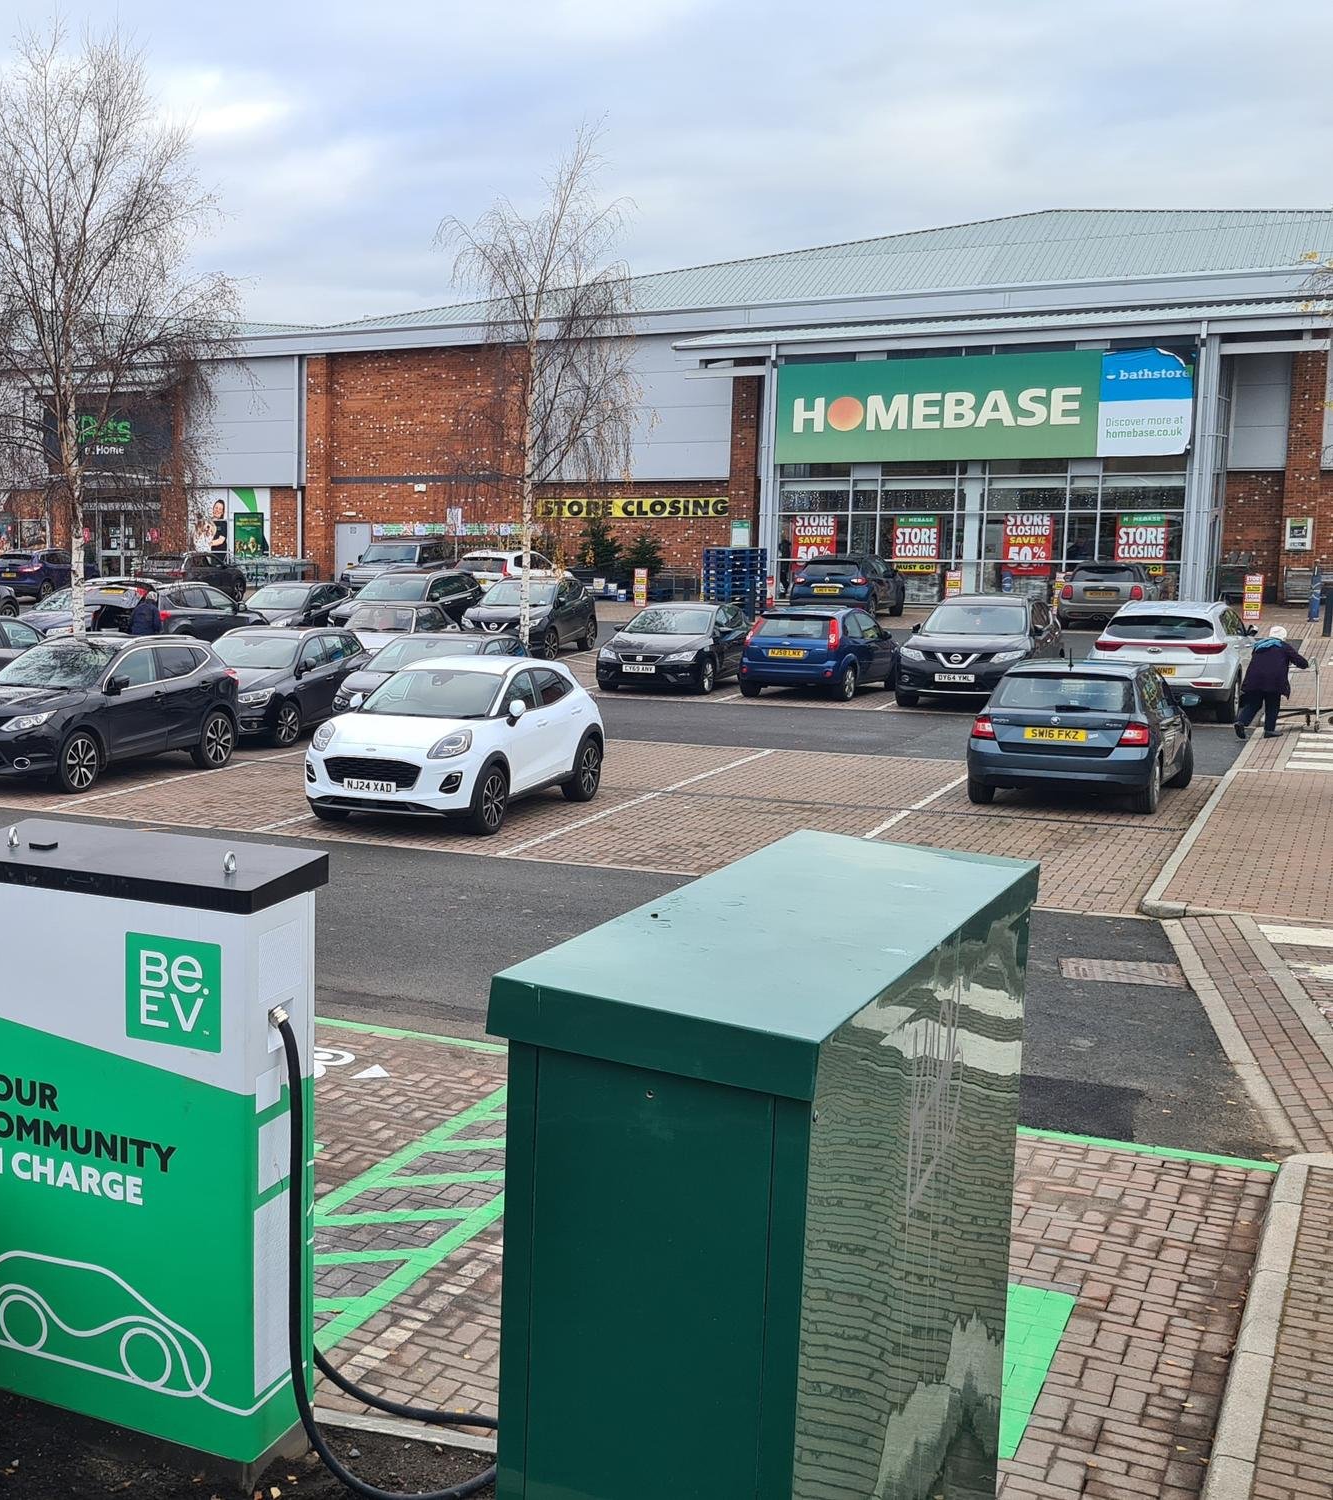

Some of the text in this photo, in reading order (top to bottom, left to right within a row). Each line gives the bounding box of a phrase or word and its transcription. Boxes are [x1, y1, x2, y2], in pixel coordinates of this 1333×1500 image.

[793, 387, 1082, 433] HOMEBASE
[1105, 415, 1184, 428] Discover more at
[1105, 426, 1183, 439] homebase.co.uk
[95, 445, 125, 456] Home
[621, 499, 729, 517] CLOSING
[795, 515, 835, 527] STORE
[1006, 514, 1051, 526] STORE
[795, 526, 835, 536] CLOSING
[895, 527, 938, 544] STORE
[1006, 525, 1050, 536] CLOSING
[1118, 527, 1166, 545] STORE
[798, 536, 822, 544] SAVE
[1009, 536, 1036, 544] SAVE
[895, 544, 937, 557] CLOSING
[1117, 544, 1165, 558] CLOSING
[1031, 728, 1079, 740] SW16 FKZ
[347, 780, 392, 793] NJ24 XAD
[140, 989, 204, 1032] EV
[11, 1151, 144, 1206] CHARGE
